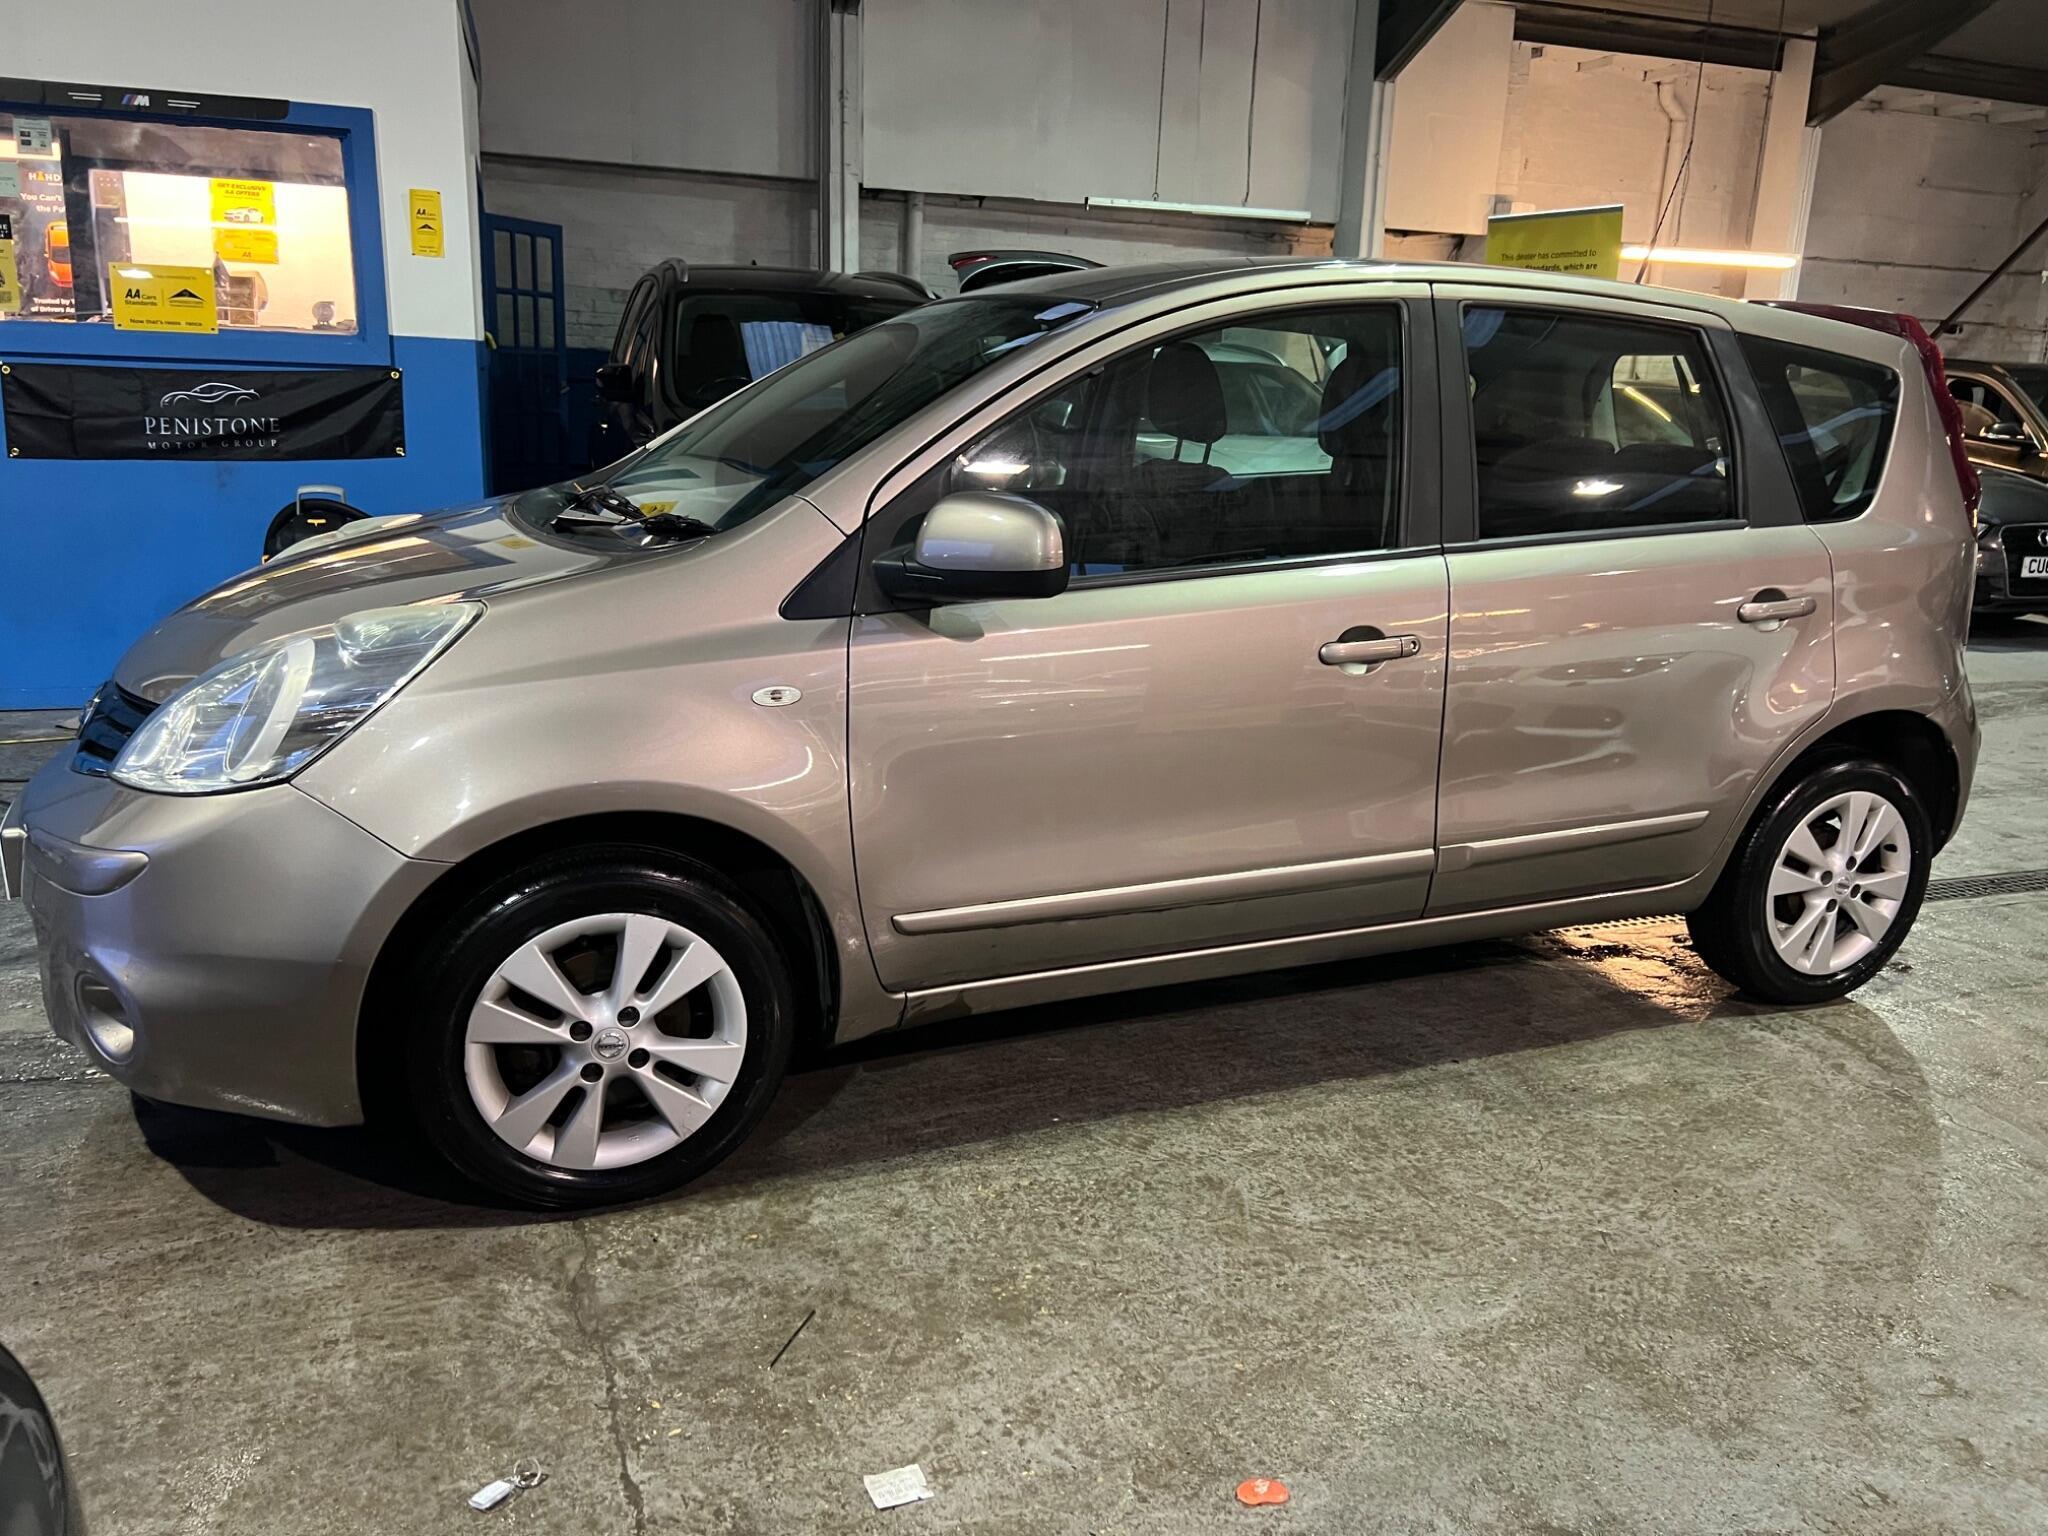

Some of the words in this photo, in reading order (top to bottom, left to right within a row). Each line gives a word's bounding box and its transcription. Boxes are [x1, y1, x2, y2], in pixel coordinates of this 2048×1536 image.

[1502, 253, 1513, 261] This
[1538, 251, 1549, 259] has
[1551, 249, 1588, 259] committed
[1589, 249, 1597, 257] to
[125, 288, 141, 298] AA
[144, 416, 280, 435] PENISTONE
[148, 441, 209, 449] MOTOR
[221, 439, 277, 448] GROUP
